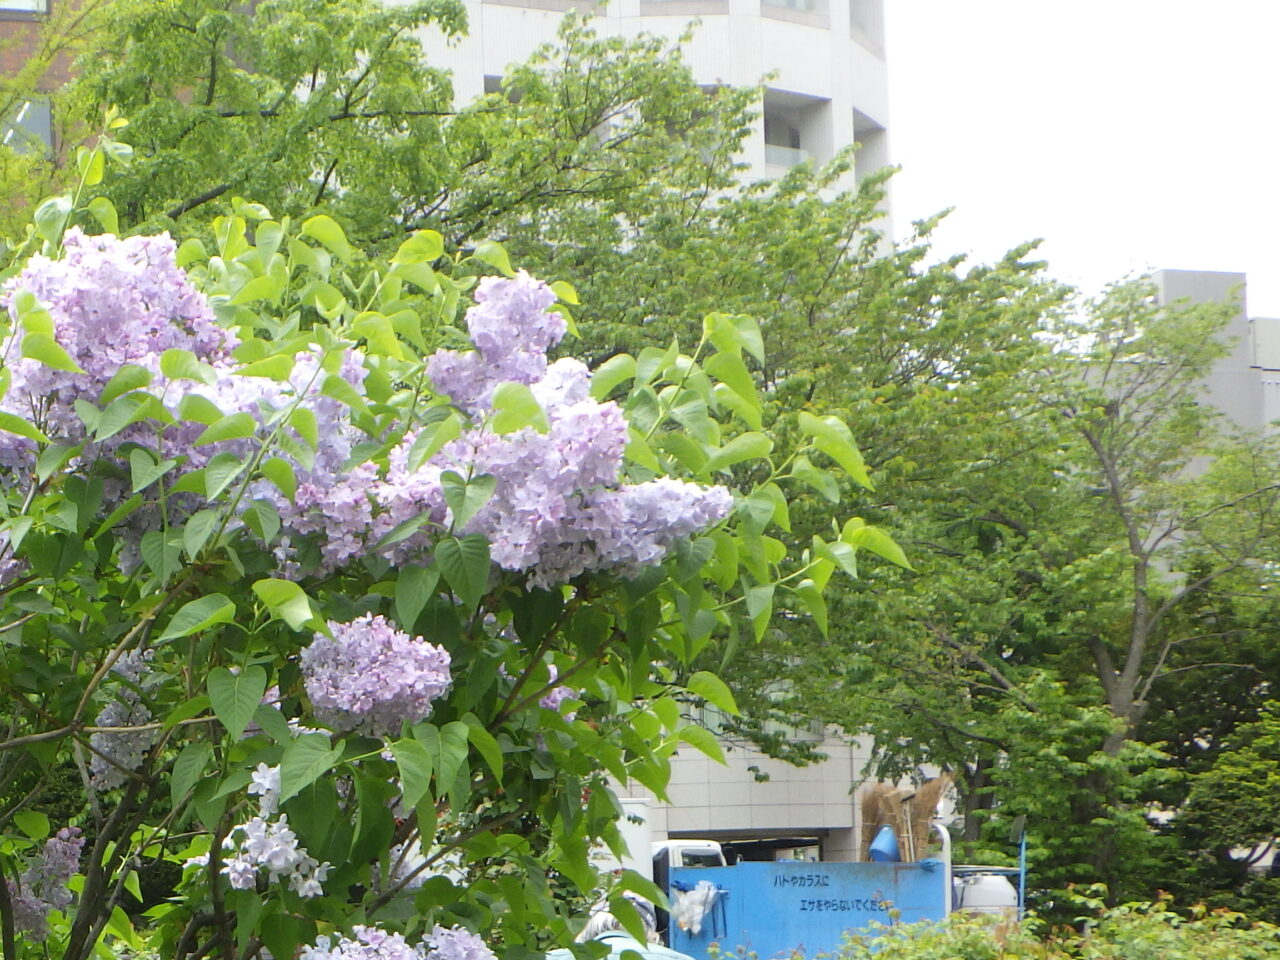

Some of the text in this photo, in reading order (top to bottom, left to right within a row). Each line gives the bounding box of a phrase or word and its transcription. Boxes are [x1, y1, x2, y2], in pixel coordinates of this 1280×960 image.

[774, 875, 829, 887] ハトやカラスに
[800, 899, 893, 912] エサをやらないでくださ
